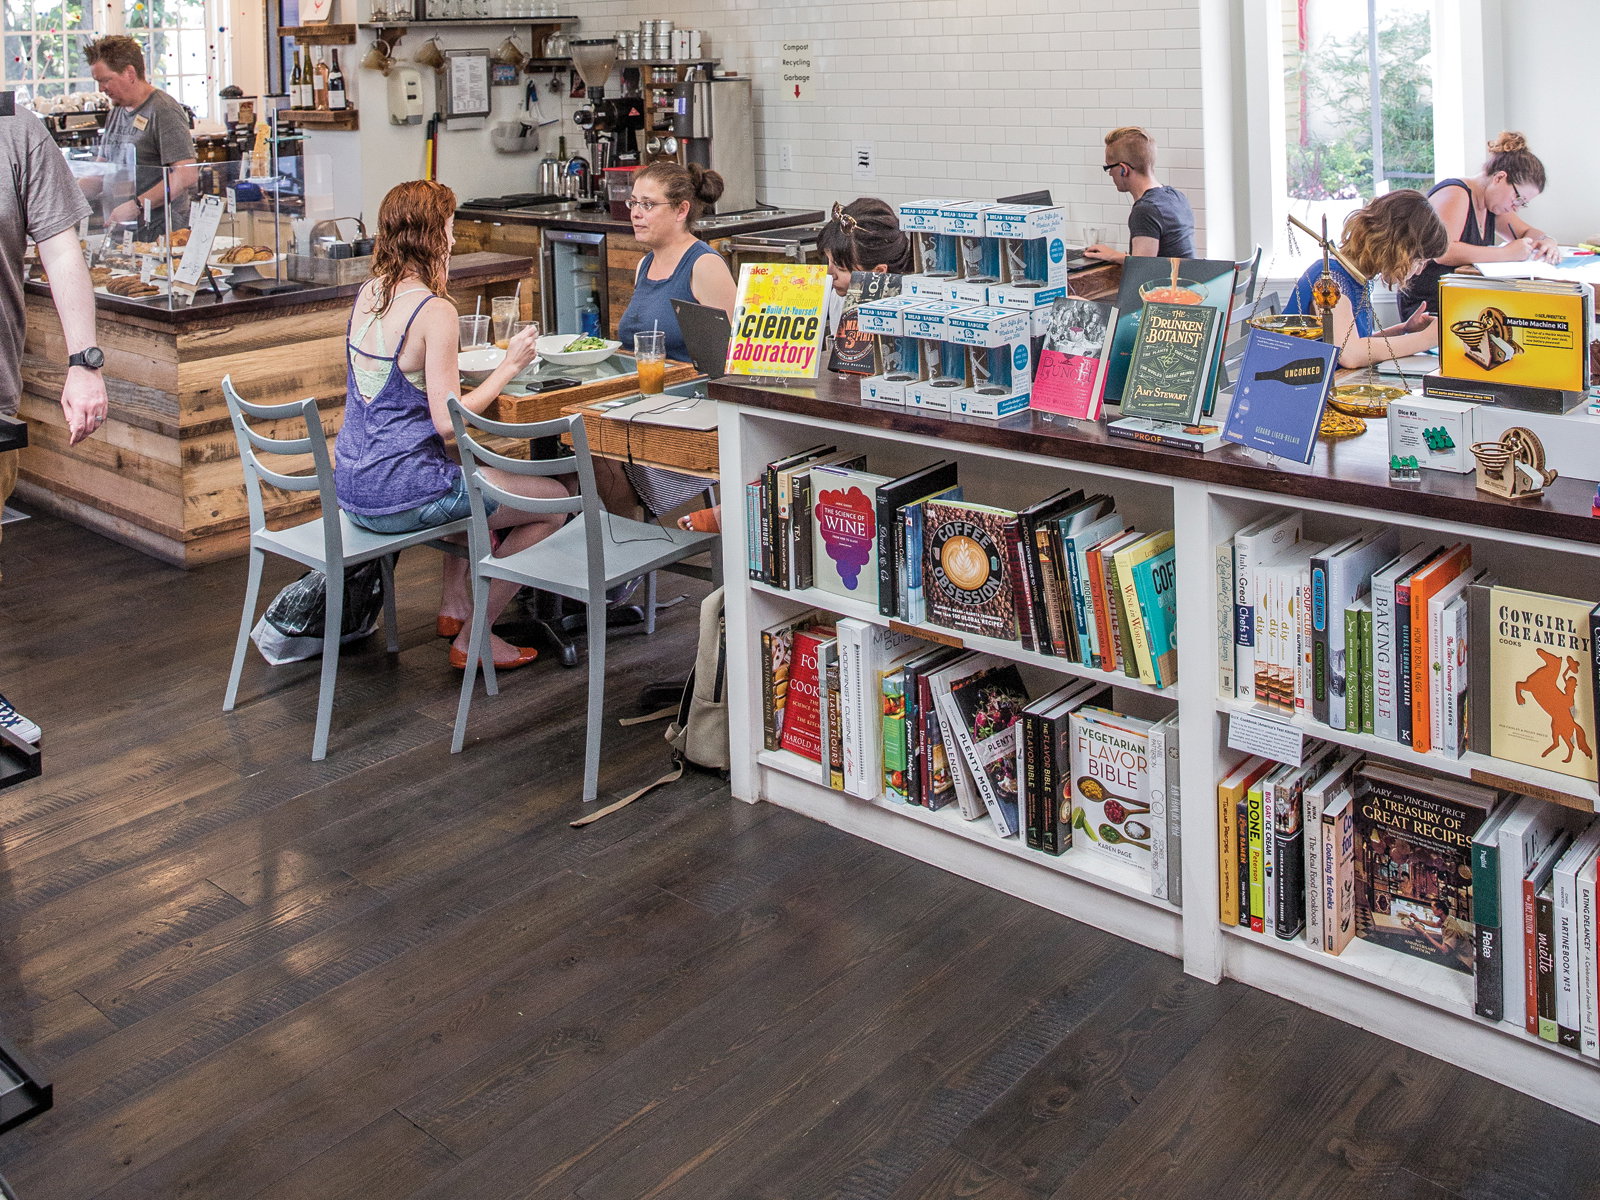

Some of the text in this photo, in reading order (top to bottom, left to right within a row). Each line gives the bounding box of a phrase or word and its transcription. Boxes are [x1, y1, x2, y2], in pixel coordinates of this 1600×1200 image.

[783, 44, 808, 52] Compost
[782, 59, 810, 67] Recycling
[784, 74, 810, 82] Garbage
[731, 306, 818, 340] Science
[766, 306, 818, 316] Build-It-Yourself
[1151, 317, 1204, 332] DRUNKEN
[1172, 310, 1185, 319] THE
[1146, 329, 1203, 347] BOTANIST
[1284, 366, 1320, 378] UNCORKED
[1134, 384, 1187, 400] AMY STEWART
[1134, 432, 1162, 442] PROOF
[824, 515, 866, 536] WINE
[835, 509, 856, 520] SCIENCE
[938, 523, 991, 549] COFFEE
[935, 567, 1000, 604] OBSESSION
[1083, 580, 1092, 610] MODERN
[1047, 565, 1062, 639] UNCOMMON GROUNDS
[1239, 577, 1250, 632] Great Chefs
[1304, 587, 1312, 636] SOUP CLUB
[1316, 604, 1324, 623] AMERICA
[961, 615, 980, 623] GLOBAL
[1108, 589, 1122, 657] BOTTLE BAR
[1124, 584, 1134, 609] WINE
[1132, 617, 1142, 649] WORDS
[1499, 605, 1577, 634] COWGIRL
[1219, 628, 1232, 662] Blossoms
[1414, 627, 1422, 644] HOW
[1499, 621, 1590, 652] CREAMERY
[1499, 638, 1522, 648] COOKS
[1374, 596, 1391, 720] BAKING BIBLE
[1415, 646, 1422, 655] TO
[842, 644, 850, 703] MODERNIST
[1415, 672, 1423, 680] AN
[1415, 681, 1423, 693] EGG
[1445, 665, 1454, 692] Creamery
[1347, 670, 1356, 715] In Season
[1363, 670, 1372, 715] In Season
[829, 693, 837, 727] FLAVOR
[1240, 716, 1257, 725] Cookbook
[783, 732, 811, 750] HAROLD
[940, 721, 961, 785] OTTOLENGHI
[988, 733, 1014, 752] PLENTY
[1026, 730, 1034, 764] FLAVOR
[1082, 726, 1145, 755] VEGETARIAN
[907, 754, 915, 781] Mekong
[928, 762, 933, 771] mi
[960, 733, 994, 806] PLENTY MORE
[1079, 737, 1148, 774] FLAVOR
[1027, 764, 1035, 788] BIBLE
[1088, 759, 1138, 790] BIBLE
[1368, 785, 1466, 819] MARY VINCENT PRICE
[1372, 797, 1461, 830] A TREASURY OF
[1250, 800, 1260, 842] DONE.
[1362, 805, 1472, 849] GREAT RECIPES
[1097, 842, 1133, 859] KAREN PAGE
[1326, 843, 1334, 873] Cooking
[1310, 870, 1318, 888] Food
[1311, 891, 1319, 927] Cookbook
[1482, 931, 1493, 958] Relæ
[1583, 915, 1591, 951] DELANCEY
[1538, 933, 1553, 975] miette
